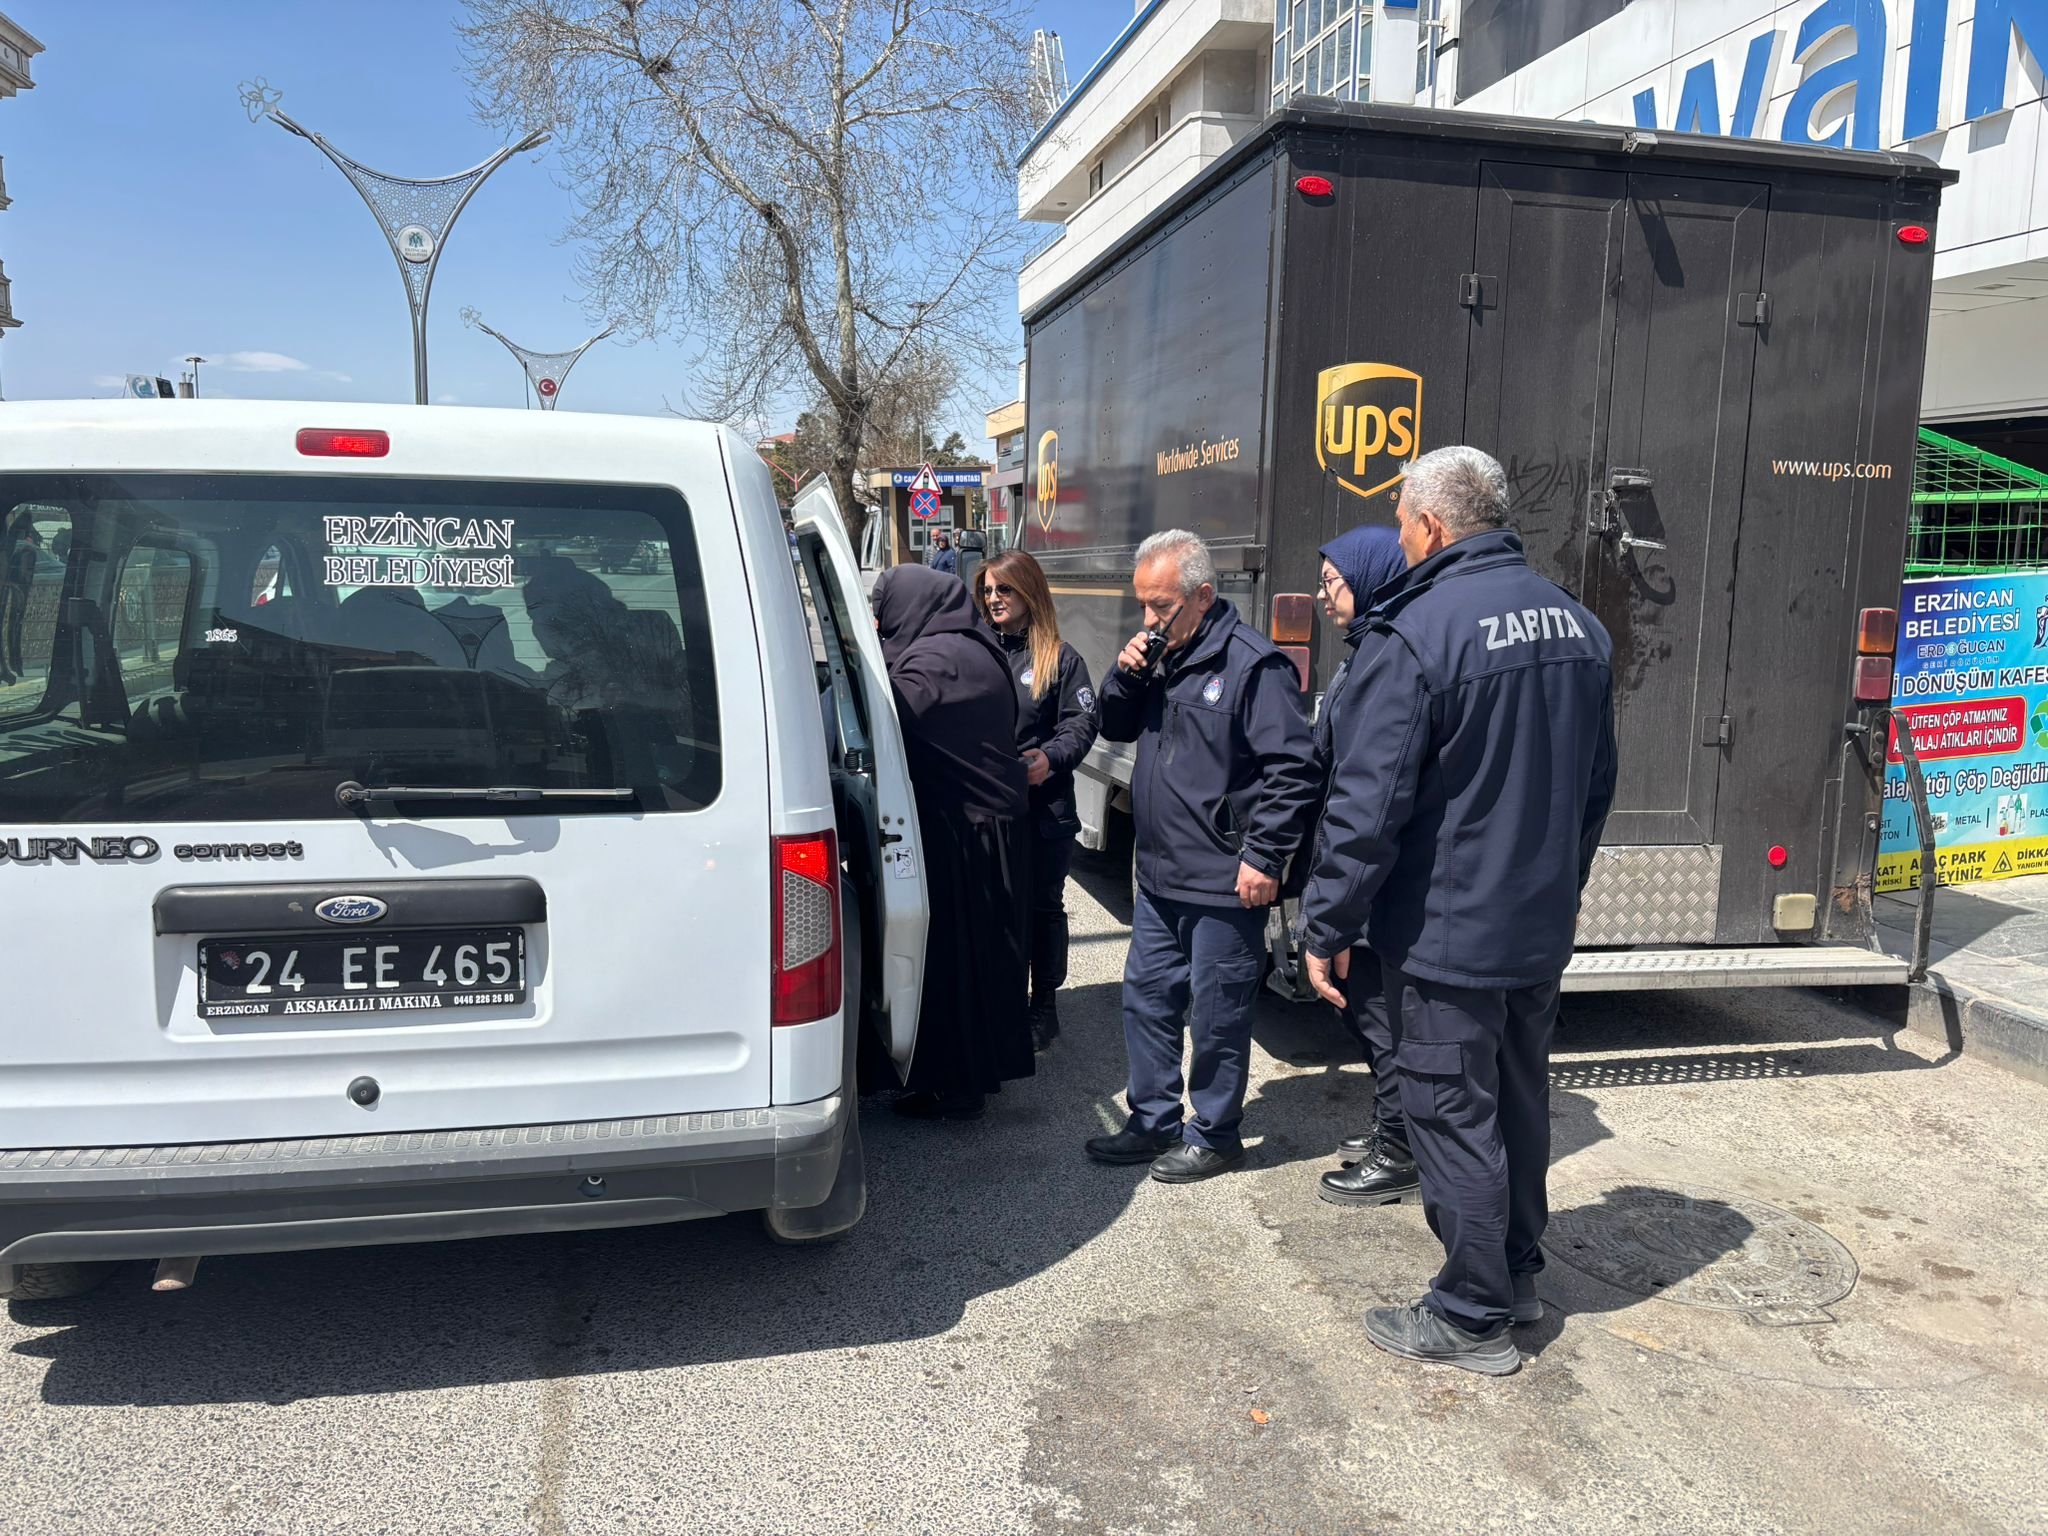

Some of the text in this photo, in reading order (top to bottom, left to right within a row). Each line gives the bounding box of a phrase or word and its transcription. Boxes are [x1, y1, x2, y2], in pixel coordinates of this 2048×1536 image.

[1157, 434, 1240, 476] Worldwide Services
[1324, 404, 1413, 476] ups
[1772, 460, 1892, 482] www.ups.com
[1039, 460, 1057, 517] ups
[323, 511, 515, 549] ERZİNCAN
[323, 553, 515, 588] BELEDİYESİ
[1914, 588, 2014, 613] ERZİNCAN
[1478, 607, 1586, 651] ZABITA
[1906, 608, 2021, 638] BELEDİYESİ
[1903, 668, 1994, 696] DÖNÜŞÜM
[1999, 666, 2048, 687] KAFE
[1942, 710, 1962, 730] ÇÖP
[1962, 708, 2008, 725] ATMAYINIZ
[1893, 723, 2018, 753] AALAJ ATIKLARI İÇİNDİR
[1883, 777, 1910, 801] alaj
[1925, 771, 1951, 798] tığı
[1955, 769, 1987, 796] Çöp
[1955, 816, 1981, 826] METAL
[0, 836, 304, 861] URNEO connect
[1951, 850, 1987, 866] PARK
[1910, 865, 1983, 887] EEYİNİZ
[2017, 861, 2043, 870] YANGIN
[331, 900, 370, 917] Ford
[245, 941, 511, 994] 24 EE 465
[284, 996, 375, 1015] AKSAKALLI
